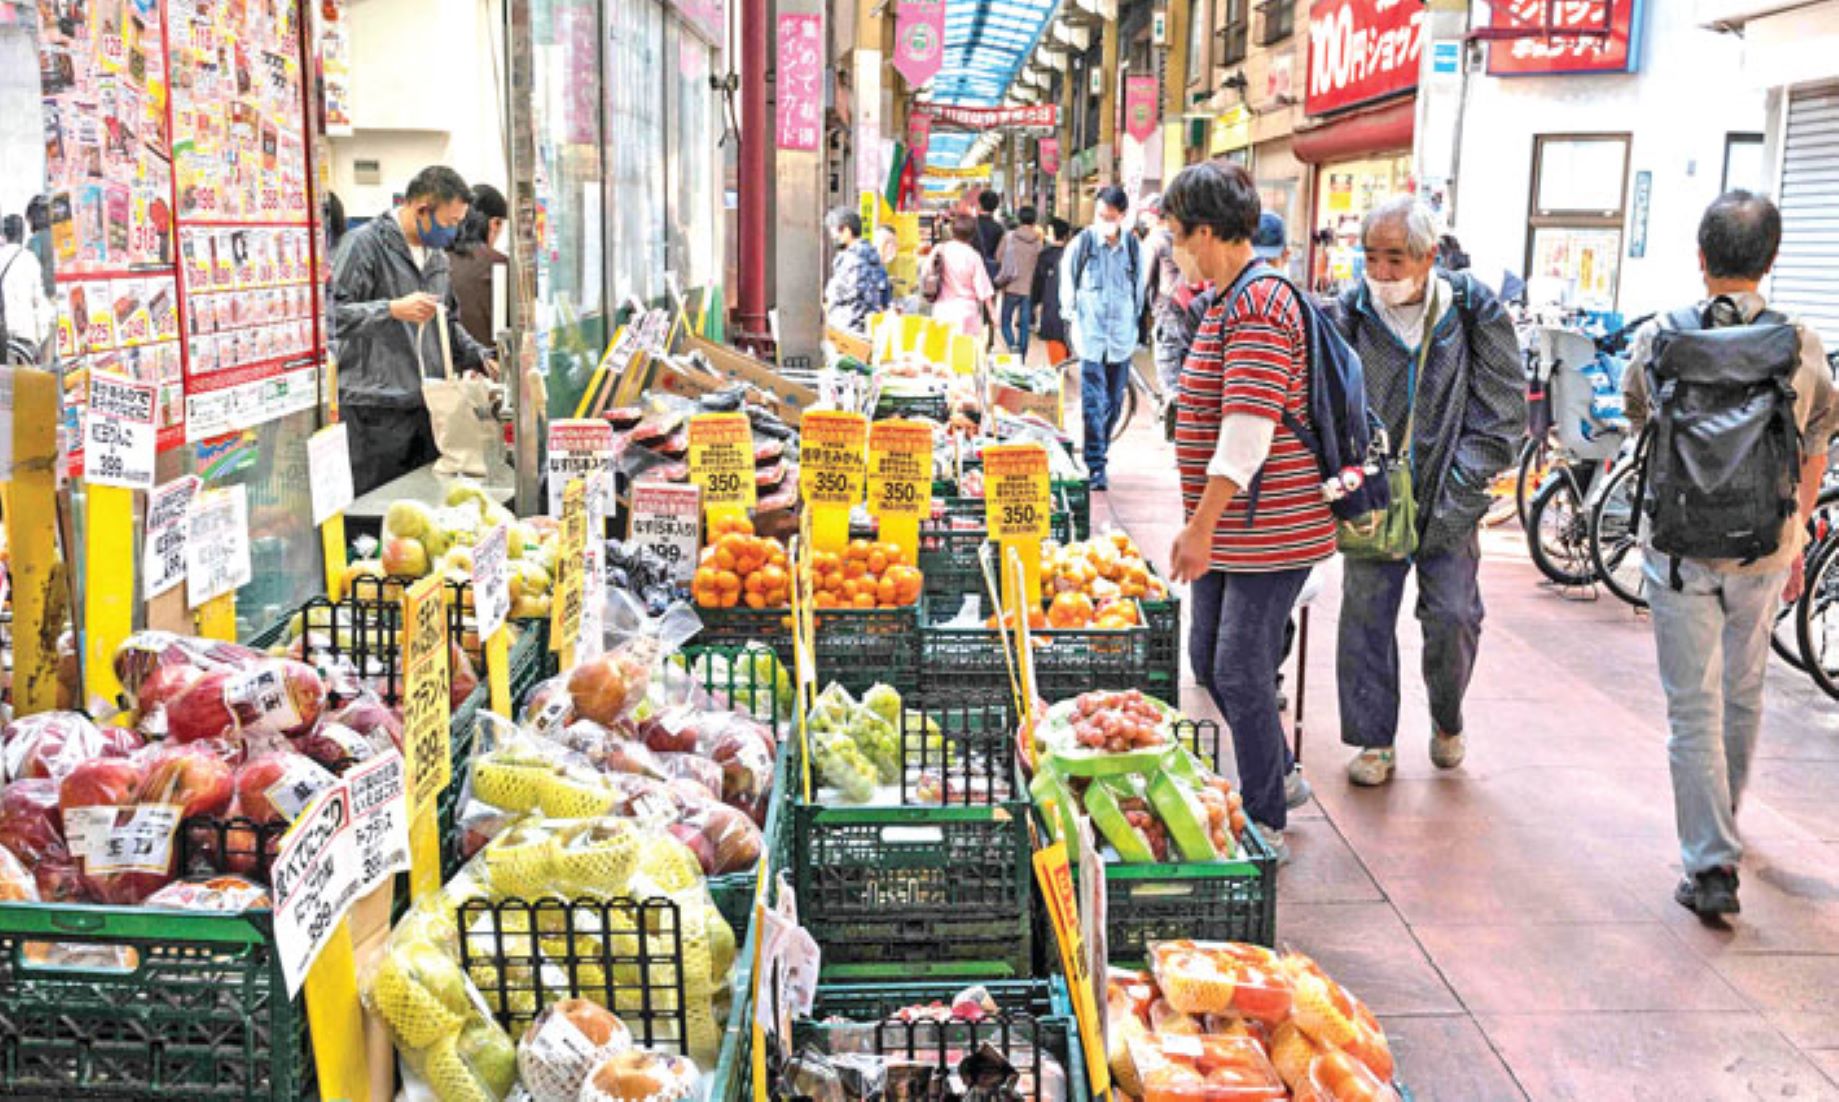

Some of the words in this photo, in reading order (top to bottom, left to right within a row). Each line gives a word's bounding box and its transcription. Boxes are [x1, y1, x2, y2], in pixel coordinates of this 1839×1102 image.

[708, 474, 740, 491] 350
[816, 472, 847, 491] 350
[883, 482, 915, 501] 350
[1003, 505, 1035, 524] 350
